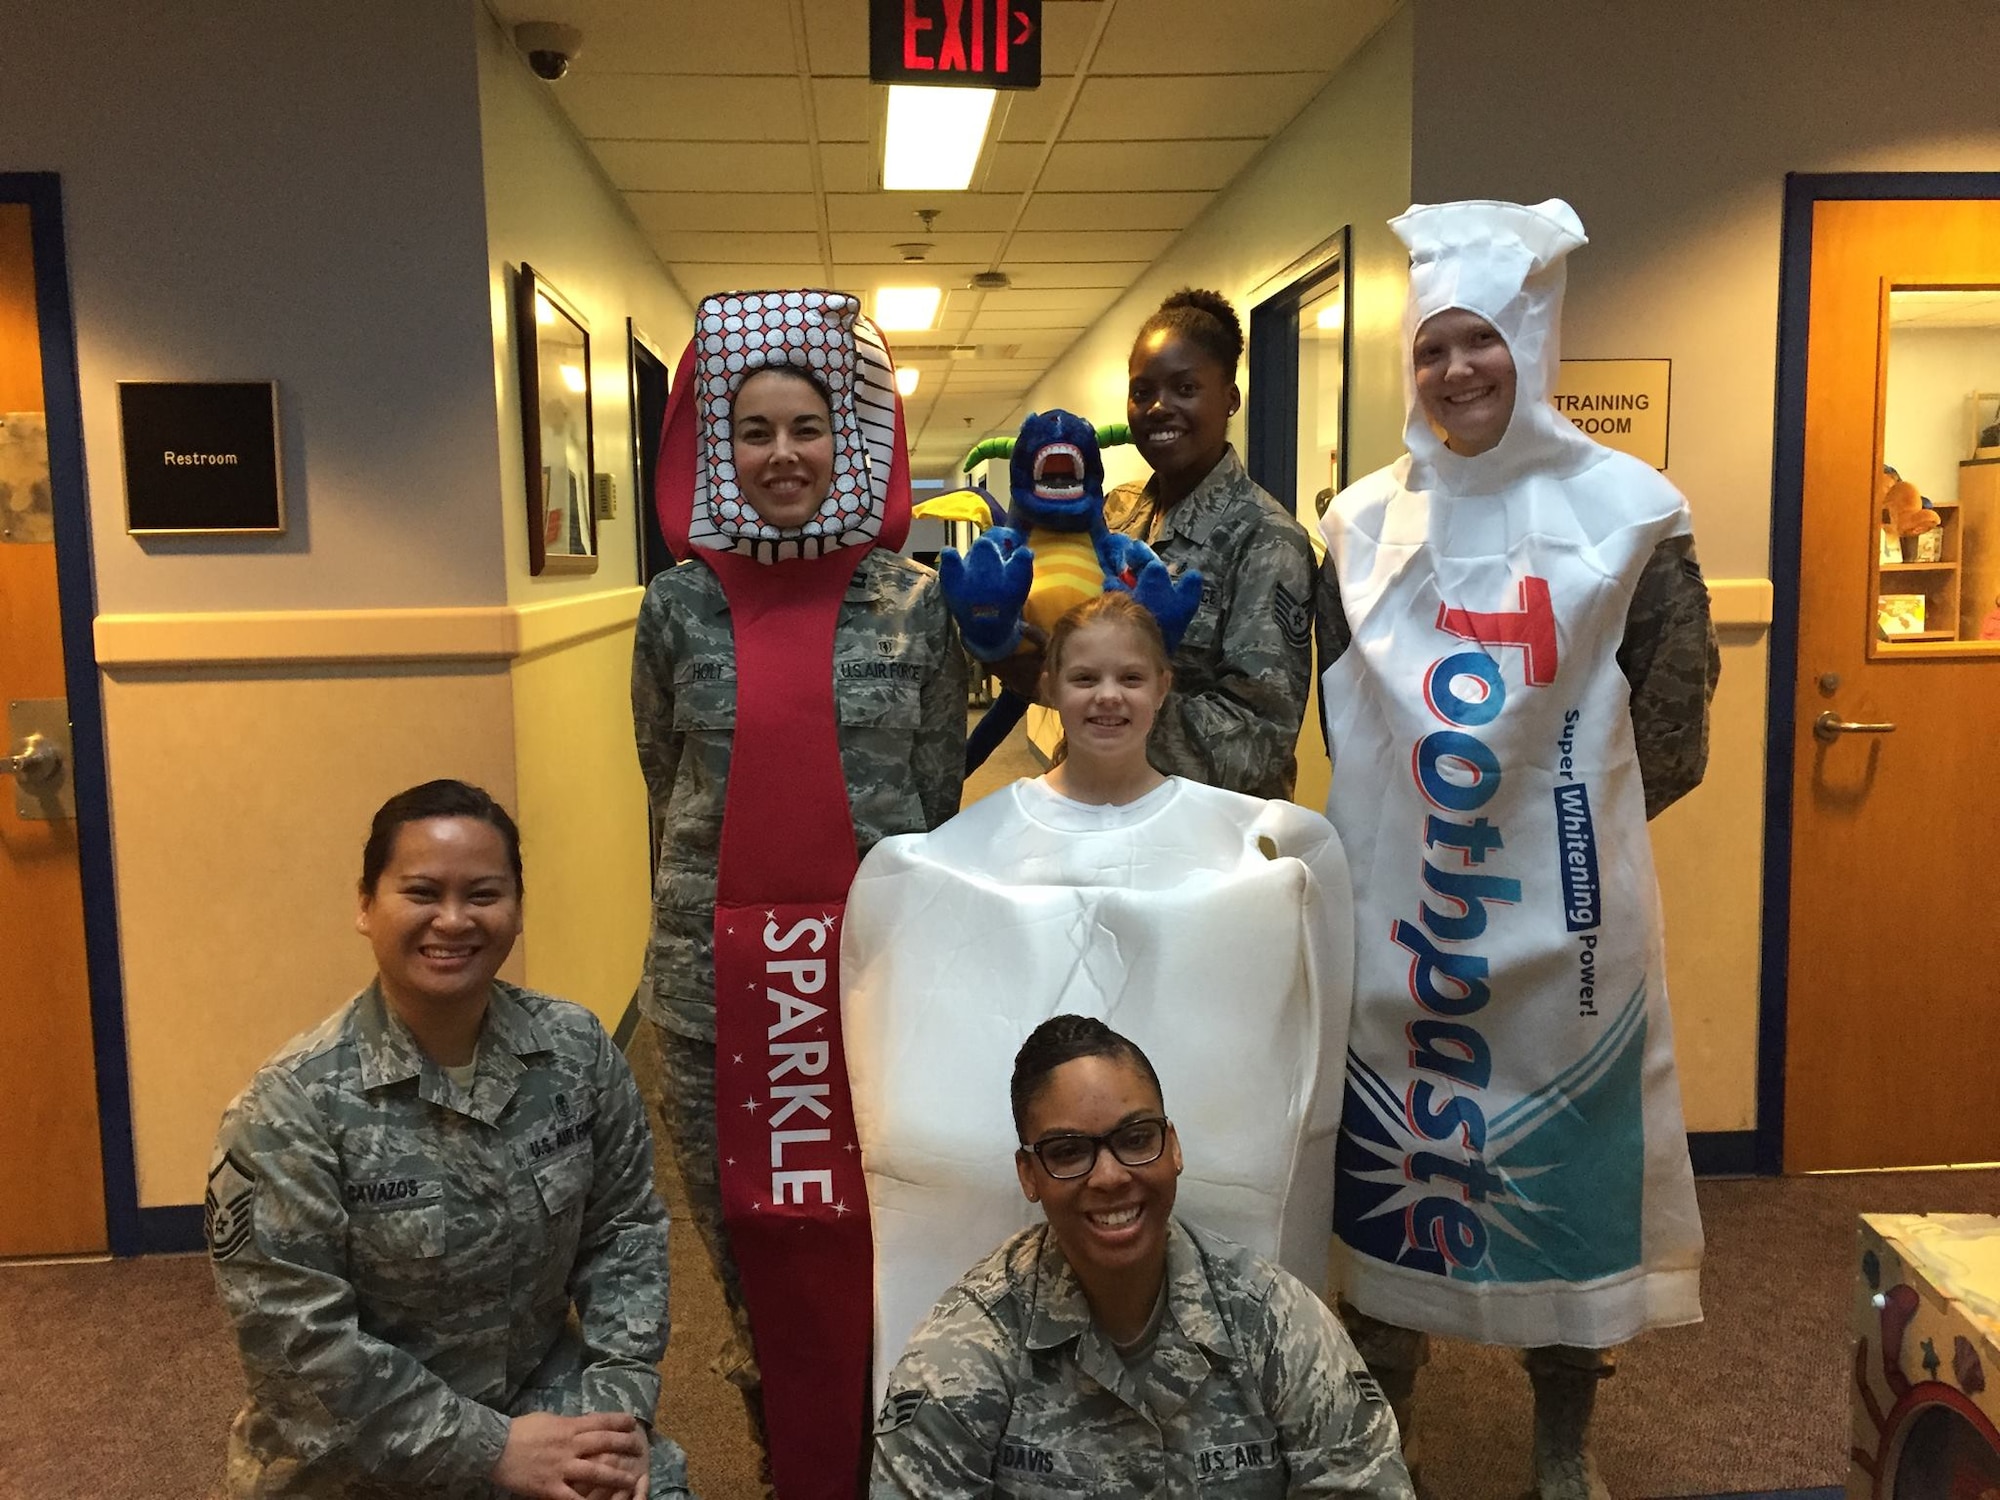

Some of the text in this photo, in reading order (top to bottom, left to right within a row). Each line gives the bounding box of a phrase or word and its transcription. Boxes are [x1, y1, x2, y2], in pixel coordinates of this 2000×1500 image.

[1554, 394, 1649, 411] TRAINING
[164, 451, 237, 465] Restroom
[693, 663, 724, 679] HOLT
[865, 662, 888, 678] AIR
[890, 662, 921, 680] FORCE
[1559, 709, 1598, 1017] Super Whitening Power!
[1390, 576, 1558, 1271] Toothpaste
[762, 918, 833, 1205] SPARKLE
[1003, 1446, 1054, 1473] DAVIS
[1235, 1444, 1264, 1468] AIR
